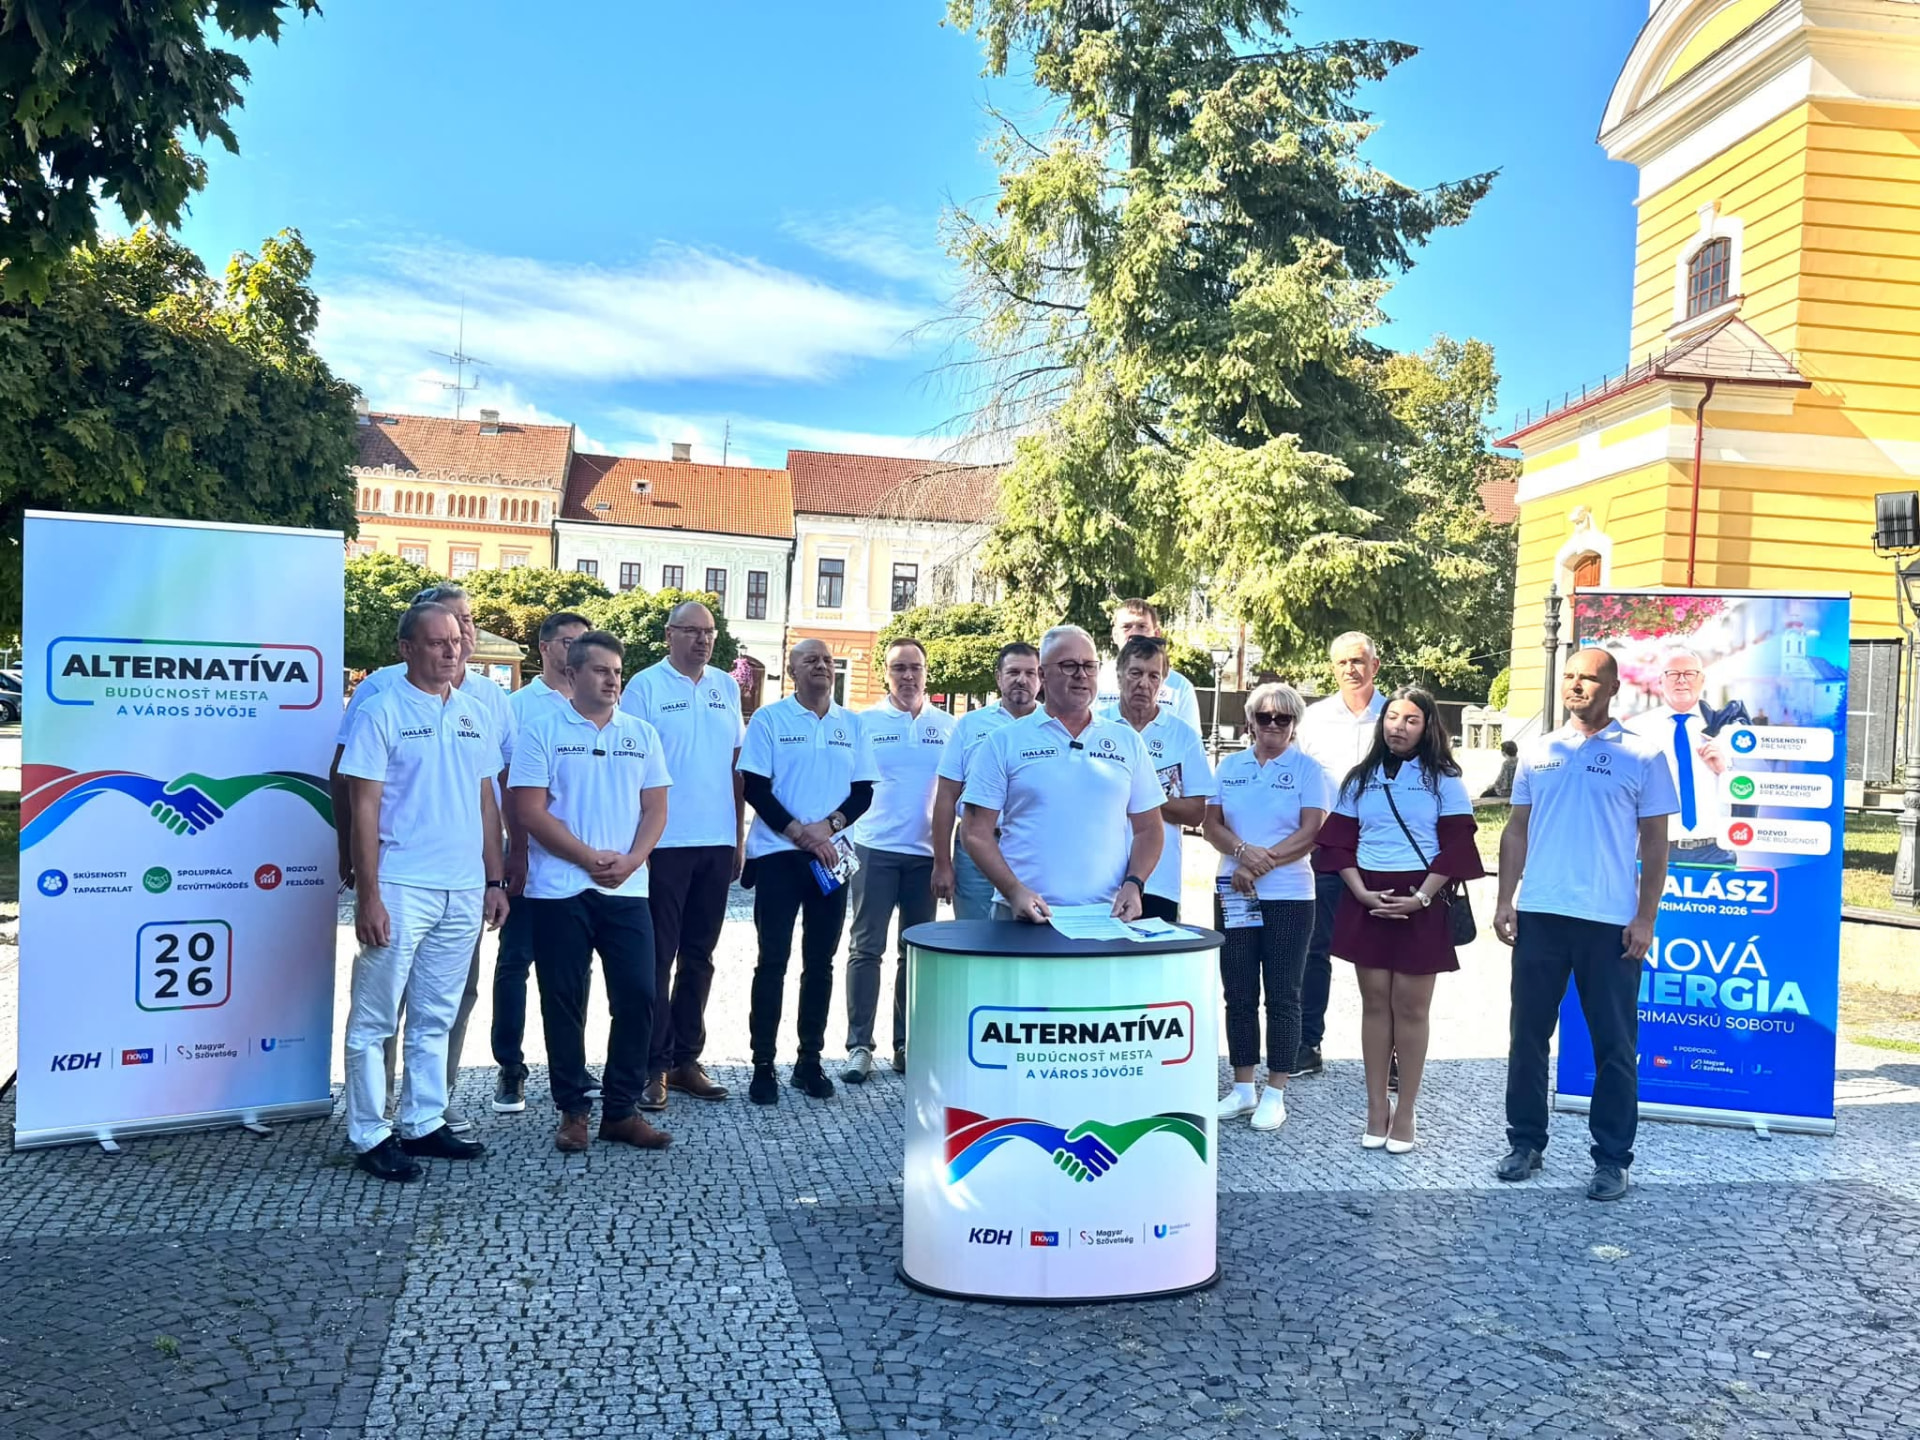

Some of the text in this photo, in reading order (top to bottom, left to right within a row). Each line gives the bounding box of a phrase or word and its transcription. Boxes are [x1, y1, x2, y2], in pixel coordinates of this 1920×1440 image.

[62, 653, 309, 683] ALTERNATÍVA
[105, 685, 269, 701] BUDÚCNOSŤ MESTA
[116, 705, 128, 716] A
[133, 703, 189, 717] VÁROS
[1022, 749, 1056, 757] HALÁSZ
[1089, 751, 1126, 763] HALÁSZ
[1586, 765, 1611, 776] SLIVA
[73, 871, 127, 879] SKÚSENOSTI
[177, 868, 232, 877] SPOLUPRÁCA
[286, 865, 317, 873] ROZVOJ
[73, 886, 133, 894] TAPASZTALAT
[1661, 872, 1768, 903] ALÁSZ
[1720, 906, 1748, 916] 2026
[155, 932, 215, 964] 20
[154, 966, 213, 999] 26
[1636, 1009, 1795, 1034] RIMAVSKÚ SOBOTU
[981, 1014, 1184, 1044] ALTERNATÍVA
[195, 1043, 225, 1052] Magyar
[126, 1053, 149, 1061] nova
[195, 1049, 237, 1059] Szövetség
[1016, 1049, 1153, 1063] BUDÚCNOSŤ MESTA
[50, 1052, 102, 1072] KDH
[1026, 1069, 1035, 1079] A
[1040, 1067, 1088, 1079] VÁROS
[968, 1227, 1013, 1245] KDH
[1096, 1229, 1123, 1238] Magyar
[1096, 1235, 1134, 1245] Szövetség
